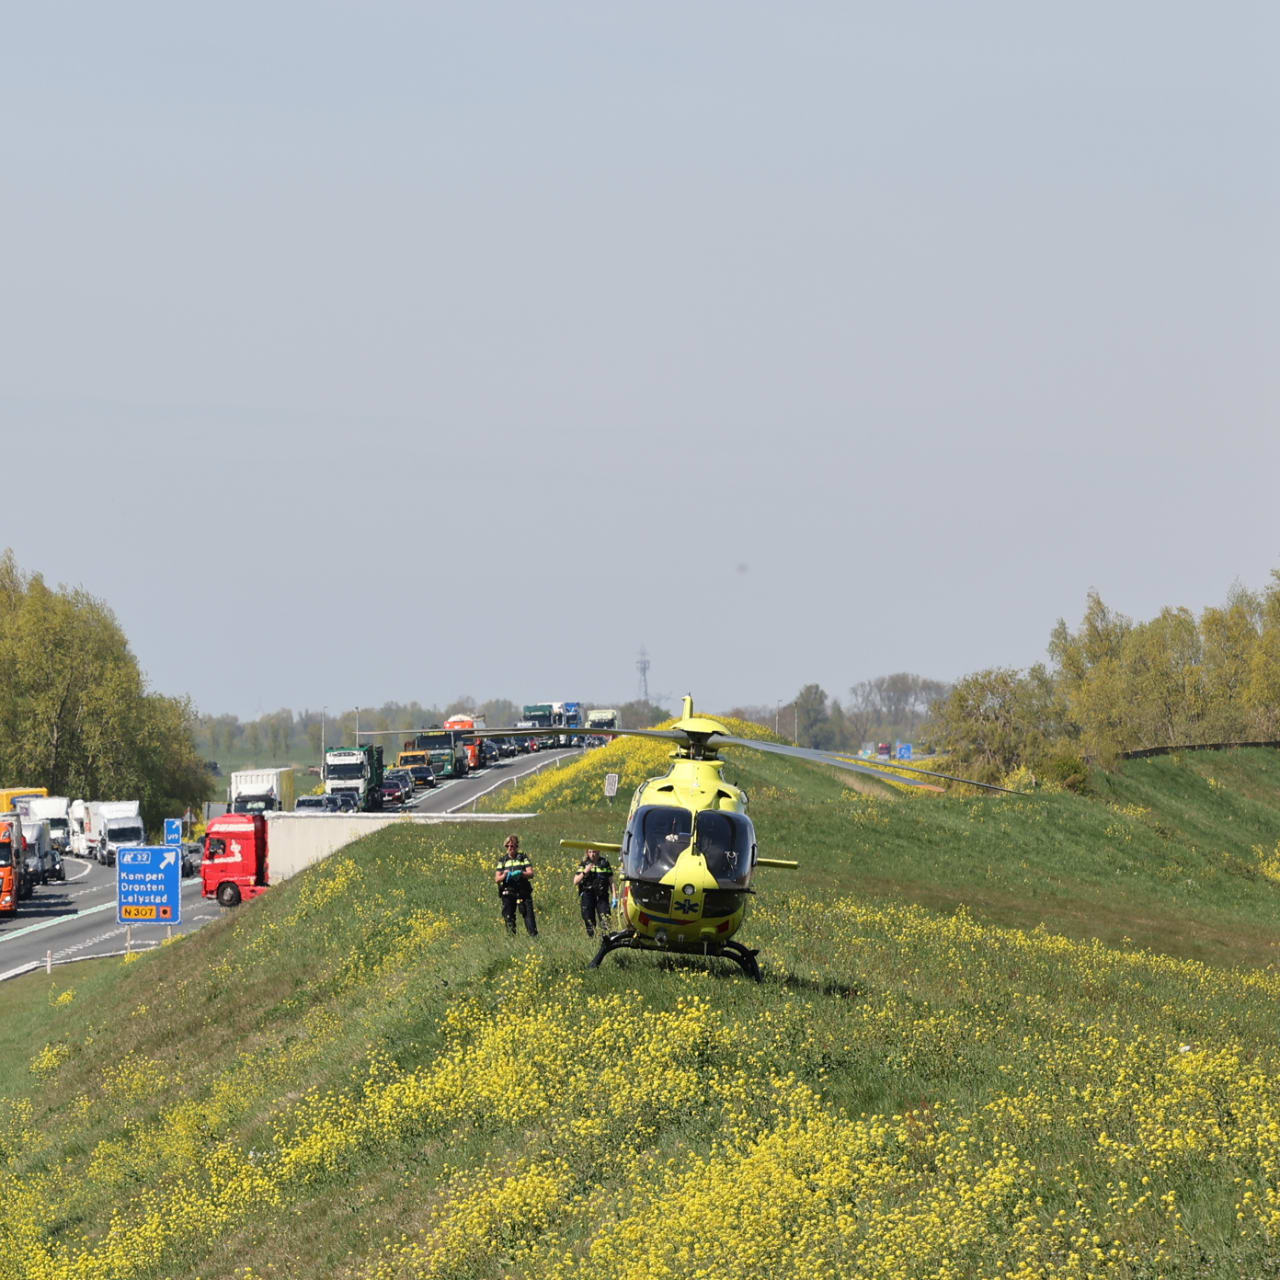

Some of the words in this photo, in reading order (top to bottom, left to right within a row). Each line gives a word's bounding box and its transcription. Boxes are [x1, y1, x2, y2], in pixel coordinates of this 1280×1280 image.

[121, 872, 165, 882] Kampen
[121, 883, 165, 892] Dronten
[121, 894, 168, 904] Lelystad
